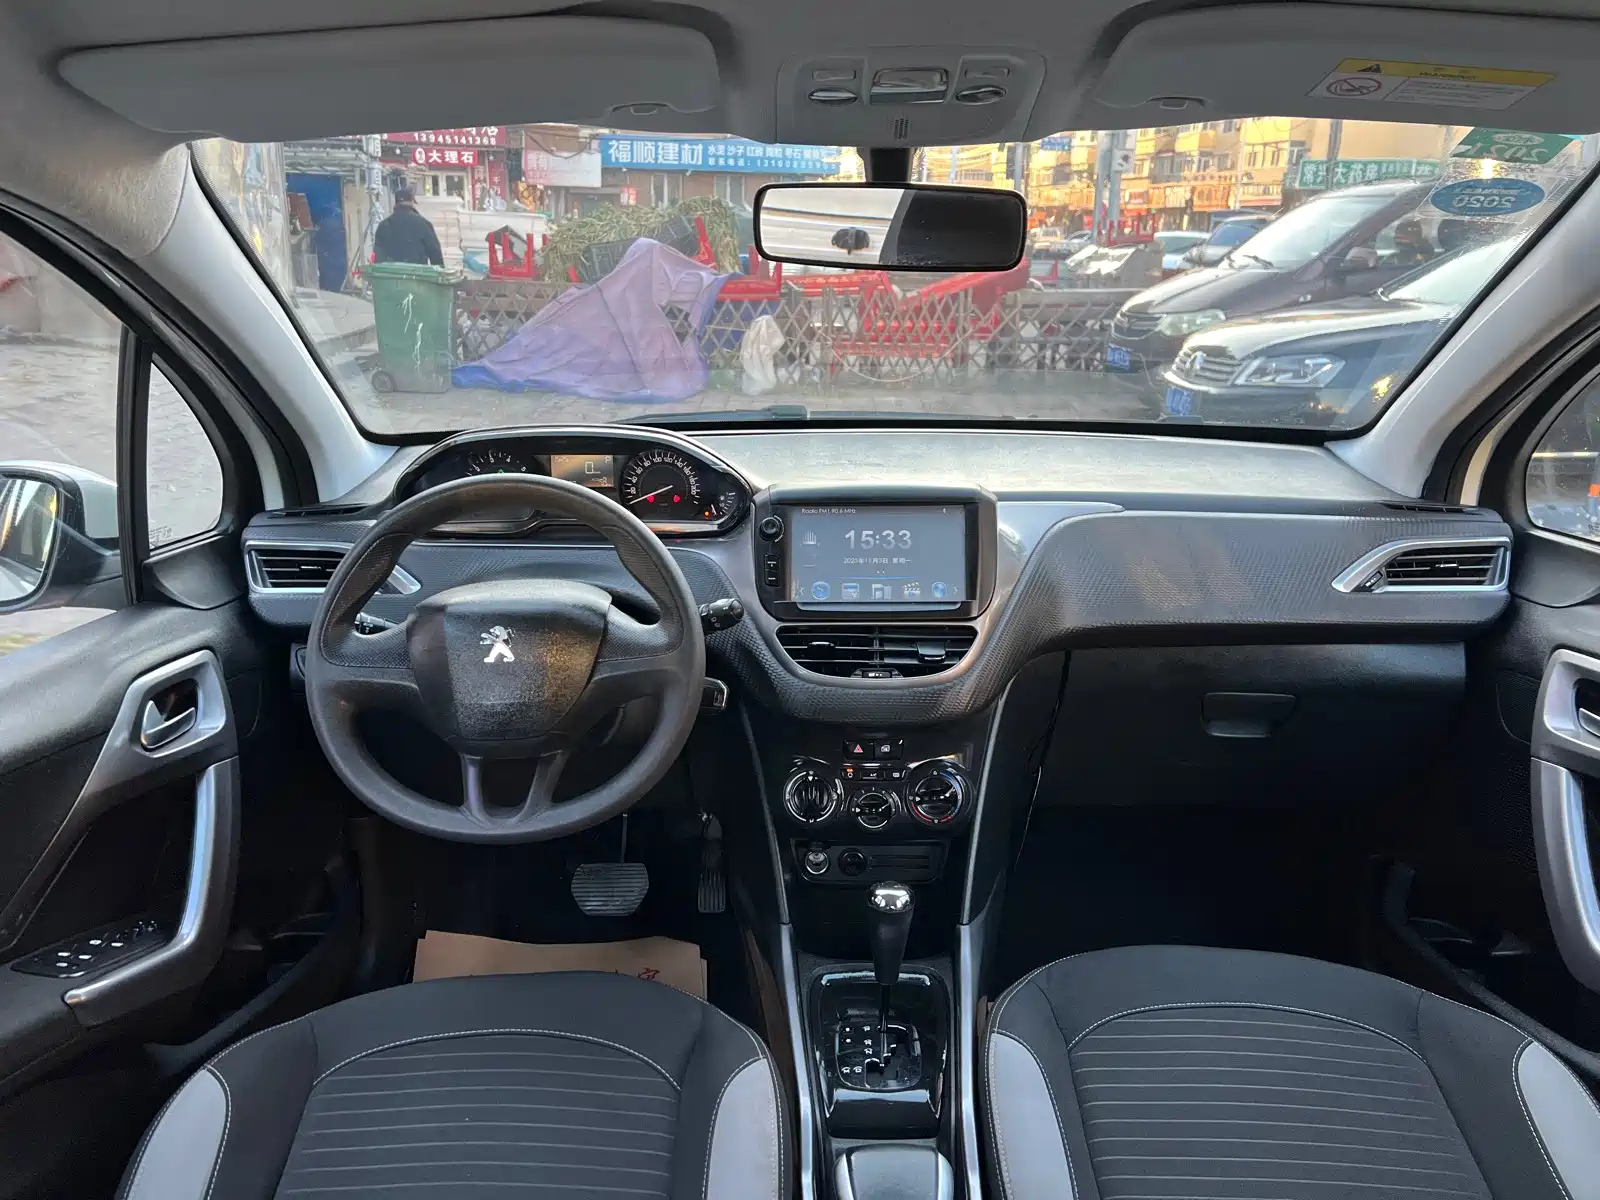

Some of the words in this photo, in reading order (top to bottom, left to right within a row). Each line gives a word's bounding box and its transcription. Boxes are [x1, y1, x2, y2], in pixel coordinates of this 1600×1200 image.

[428, 149, 475, 164] 大理石
[608, 140, 703, 165] 福顺建材
[844, 529, 912, 550] 15:33
